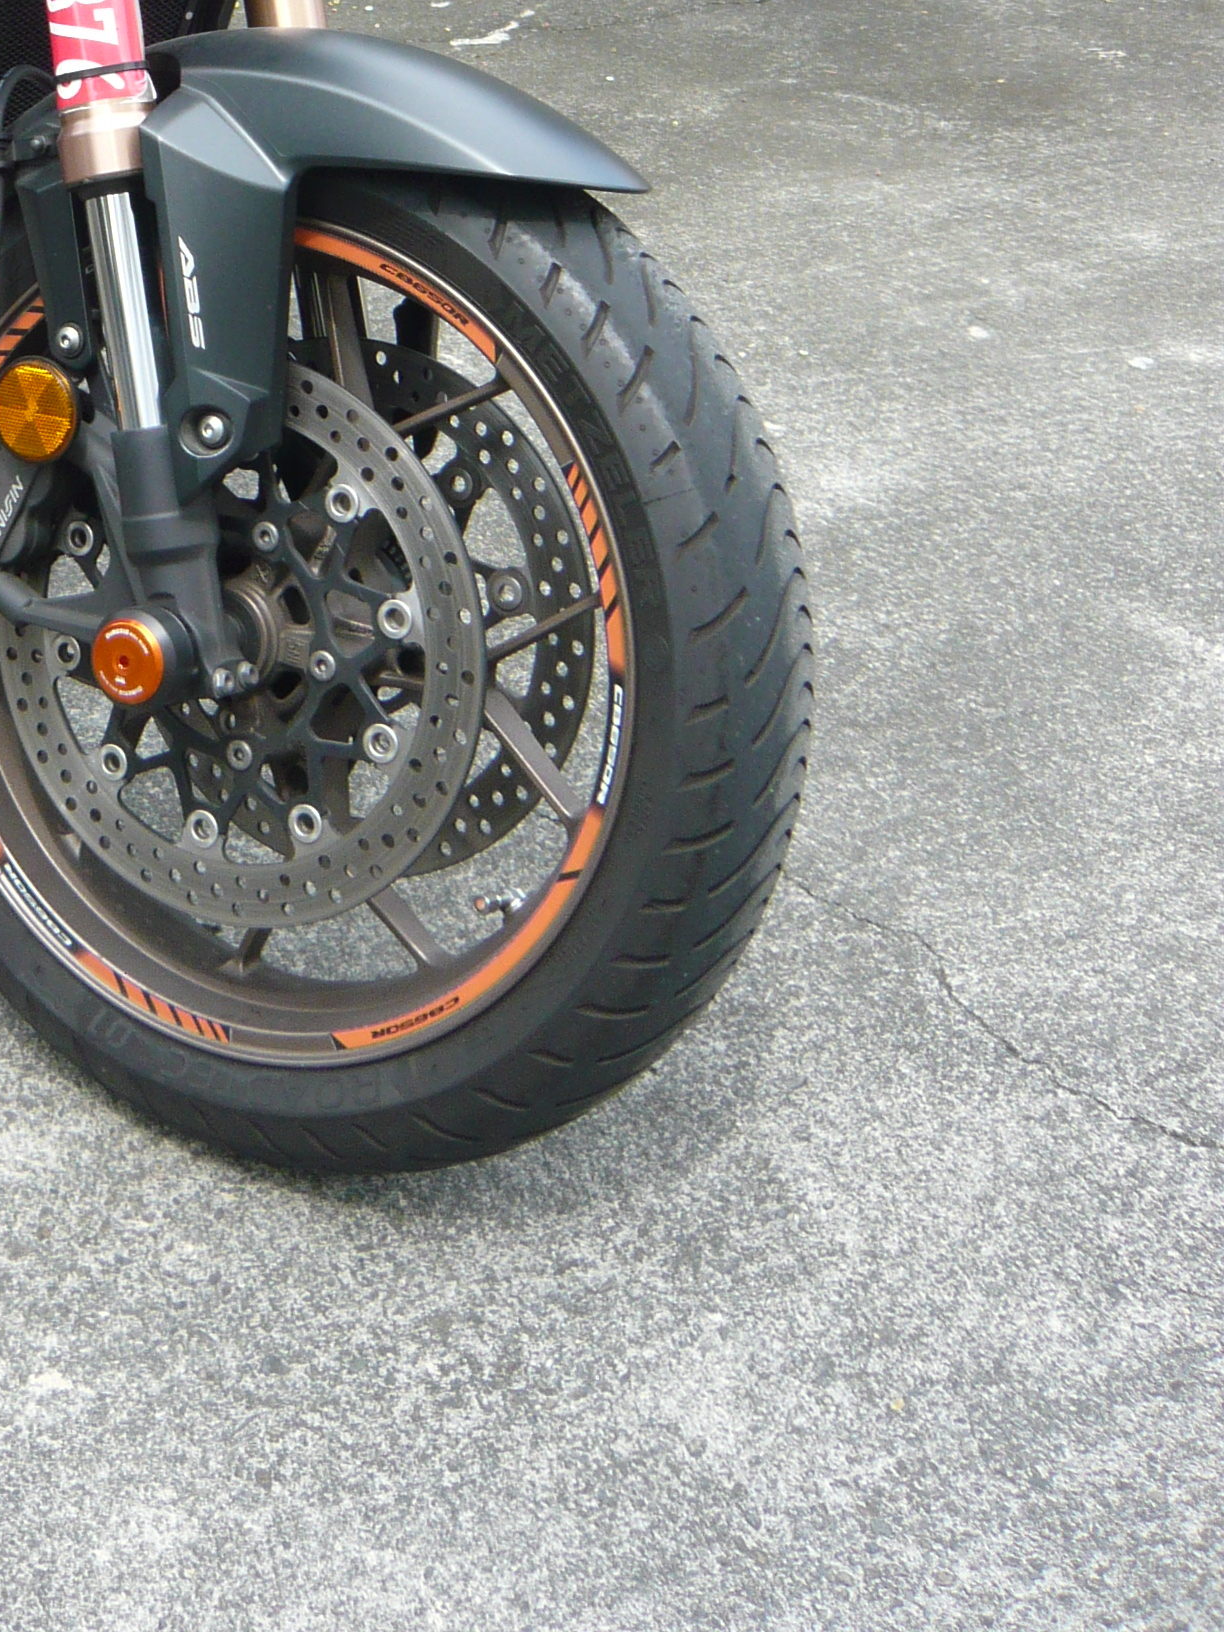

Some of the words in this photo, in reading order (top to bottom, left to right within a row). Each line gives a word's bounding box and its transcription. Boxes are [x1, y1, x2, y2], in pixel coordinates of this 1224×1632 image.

[178, 235, 206, 350] ABS
[379, 262, 470, 327] CB650R
[370, 996, 460, 1040] CB650R
